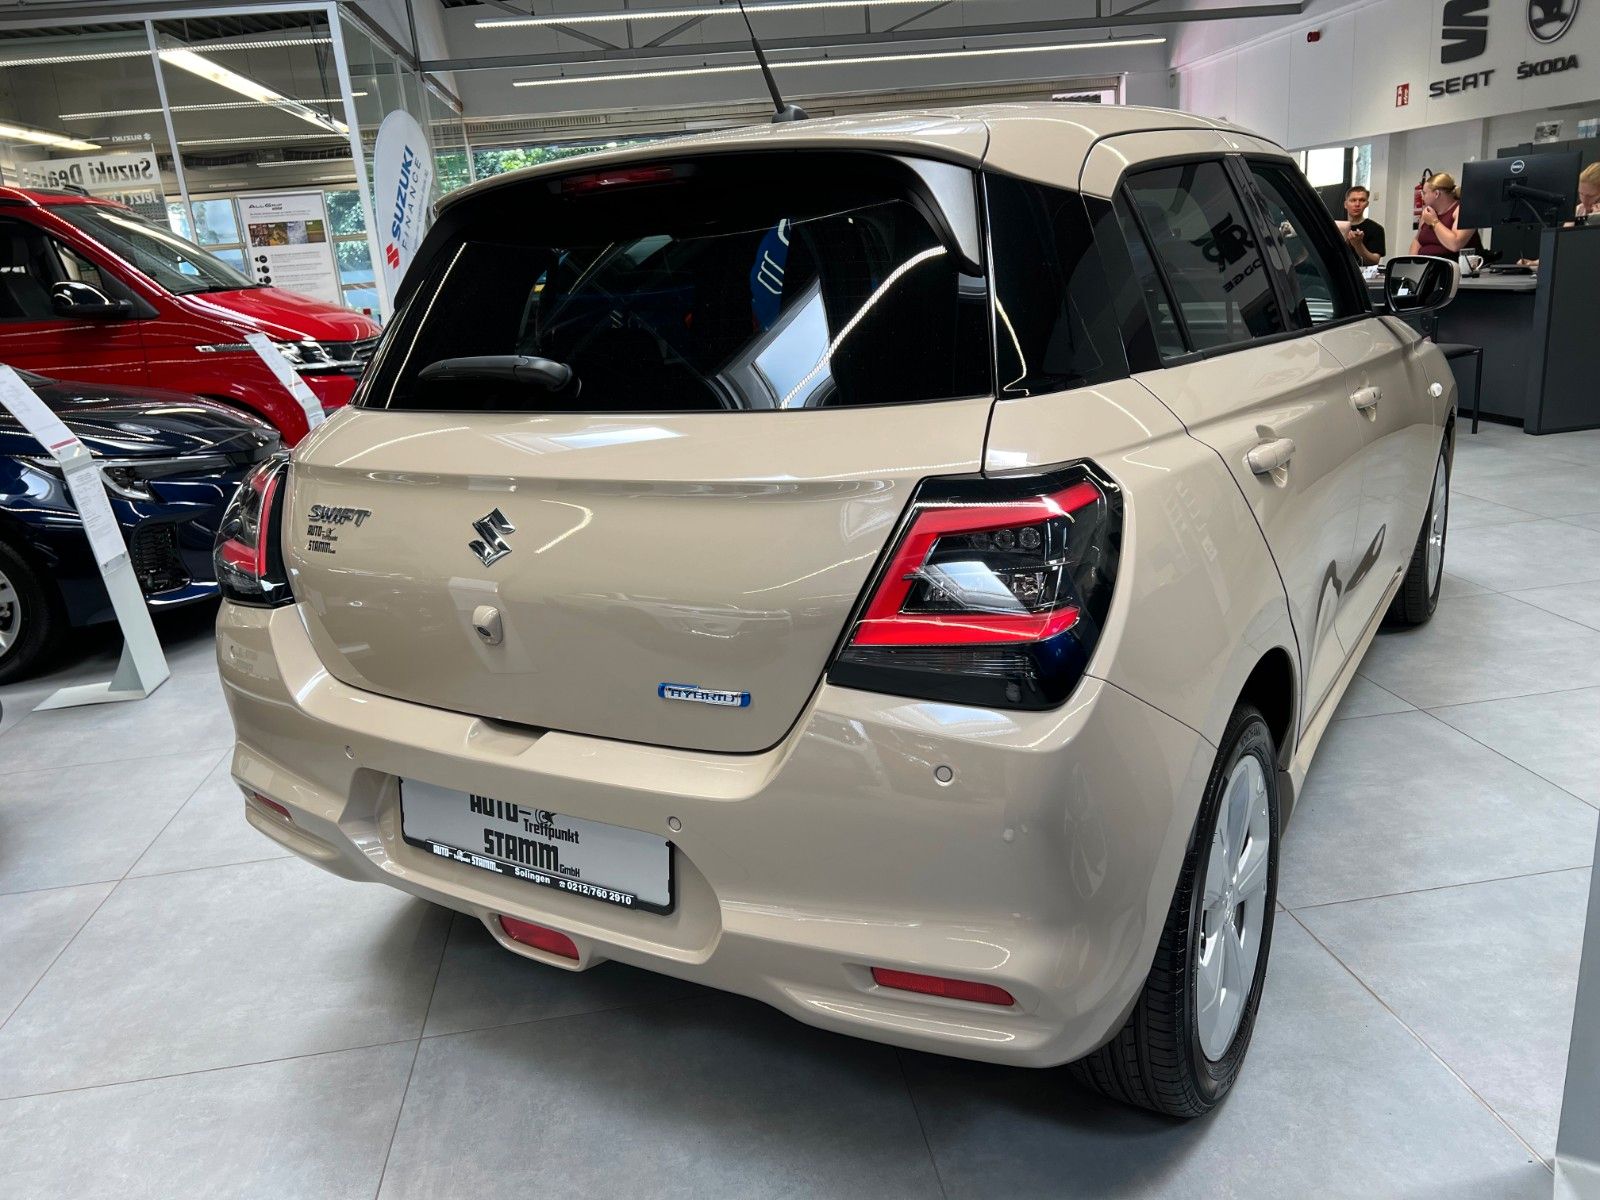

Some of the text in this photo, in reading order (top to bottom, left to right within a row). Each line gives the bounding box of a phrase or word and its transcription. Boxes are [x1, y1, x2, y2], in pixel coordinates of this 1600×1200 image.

[1517, 54, 1579, 80] ŠKODA
[1429, 69, 1495, 97] SEAT
[392, 144, 414, 241] SUZUKI
[402, 156, 421, 250] FINANCE
[308, 504, 371, 527] SWIFT
[670, 688, 736, 703] HYBRID
[524, 818, 580, 844] Treffpunkt
[484, 828, 580, 877] STAMM GmbH
[515, 867, 551, 884] Solingen
[567, 881, 607, 899] 0212/760
[609, 893, 632, 905] 2910
